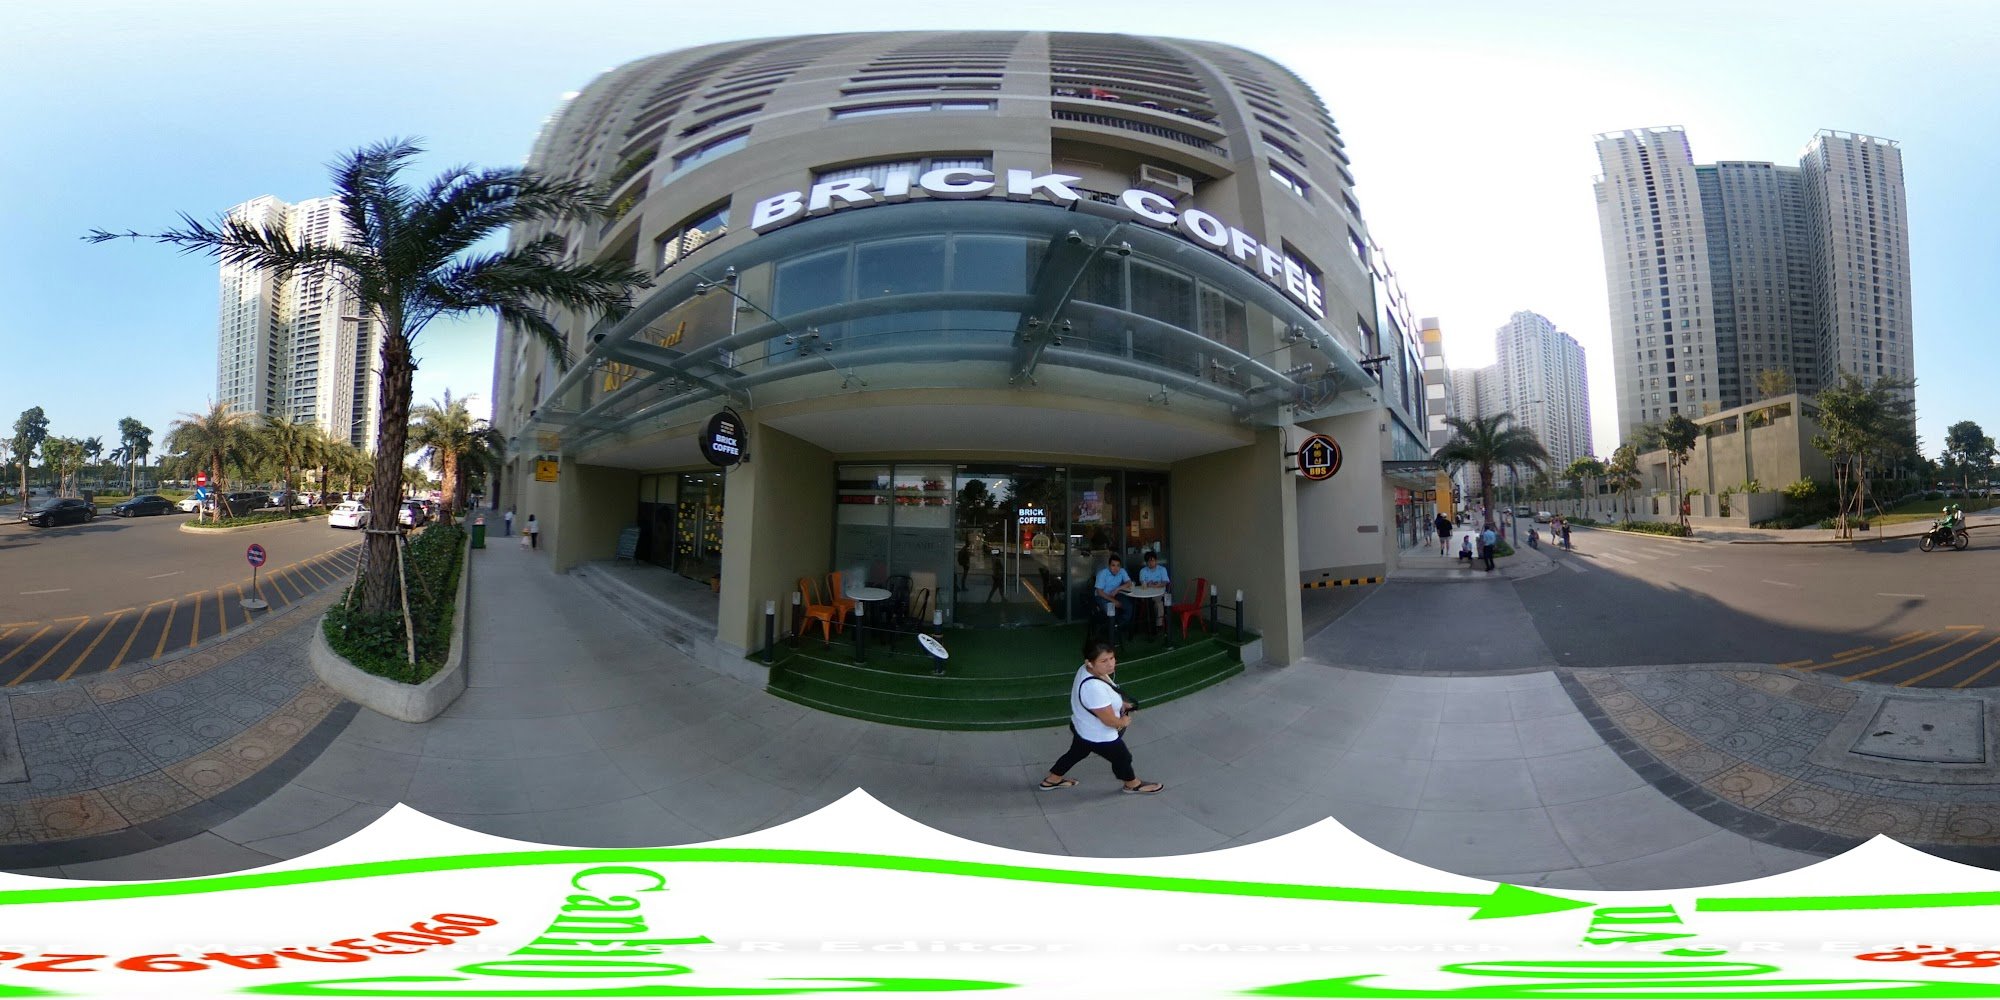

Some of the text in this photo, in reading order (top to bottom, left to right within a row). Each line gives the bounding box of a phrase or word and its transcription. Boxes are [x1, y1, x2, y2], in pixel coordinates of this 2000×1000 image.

[751, 167, 1326, 320] BRICK COFFEE
[715, 434, 737, 446] BRICK
[712, 443, 739, 455] COFFEE
[1018, 508, 1044, 516] BRICK
[1019, 516, 1047, 524] COFFEE
